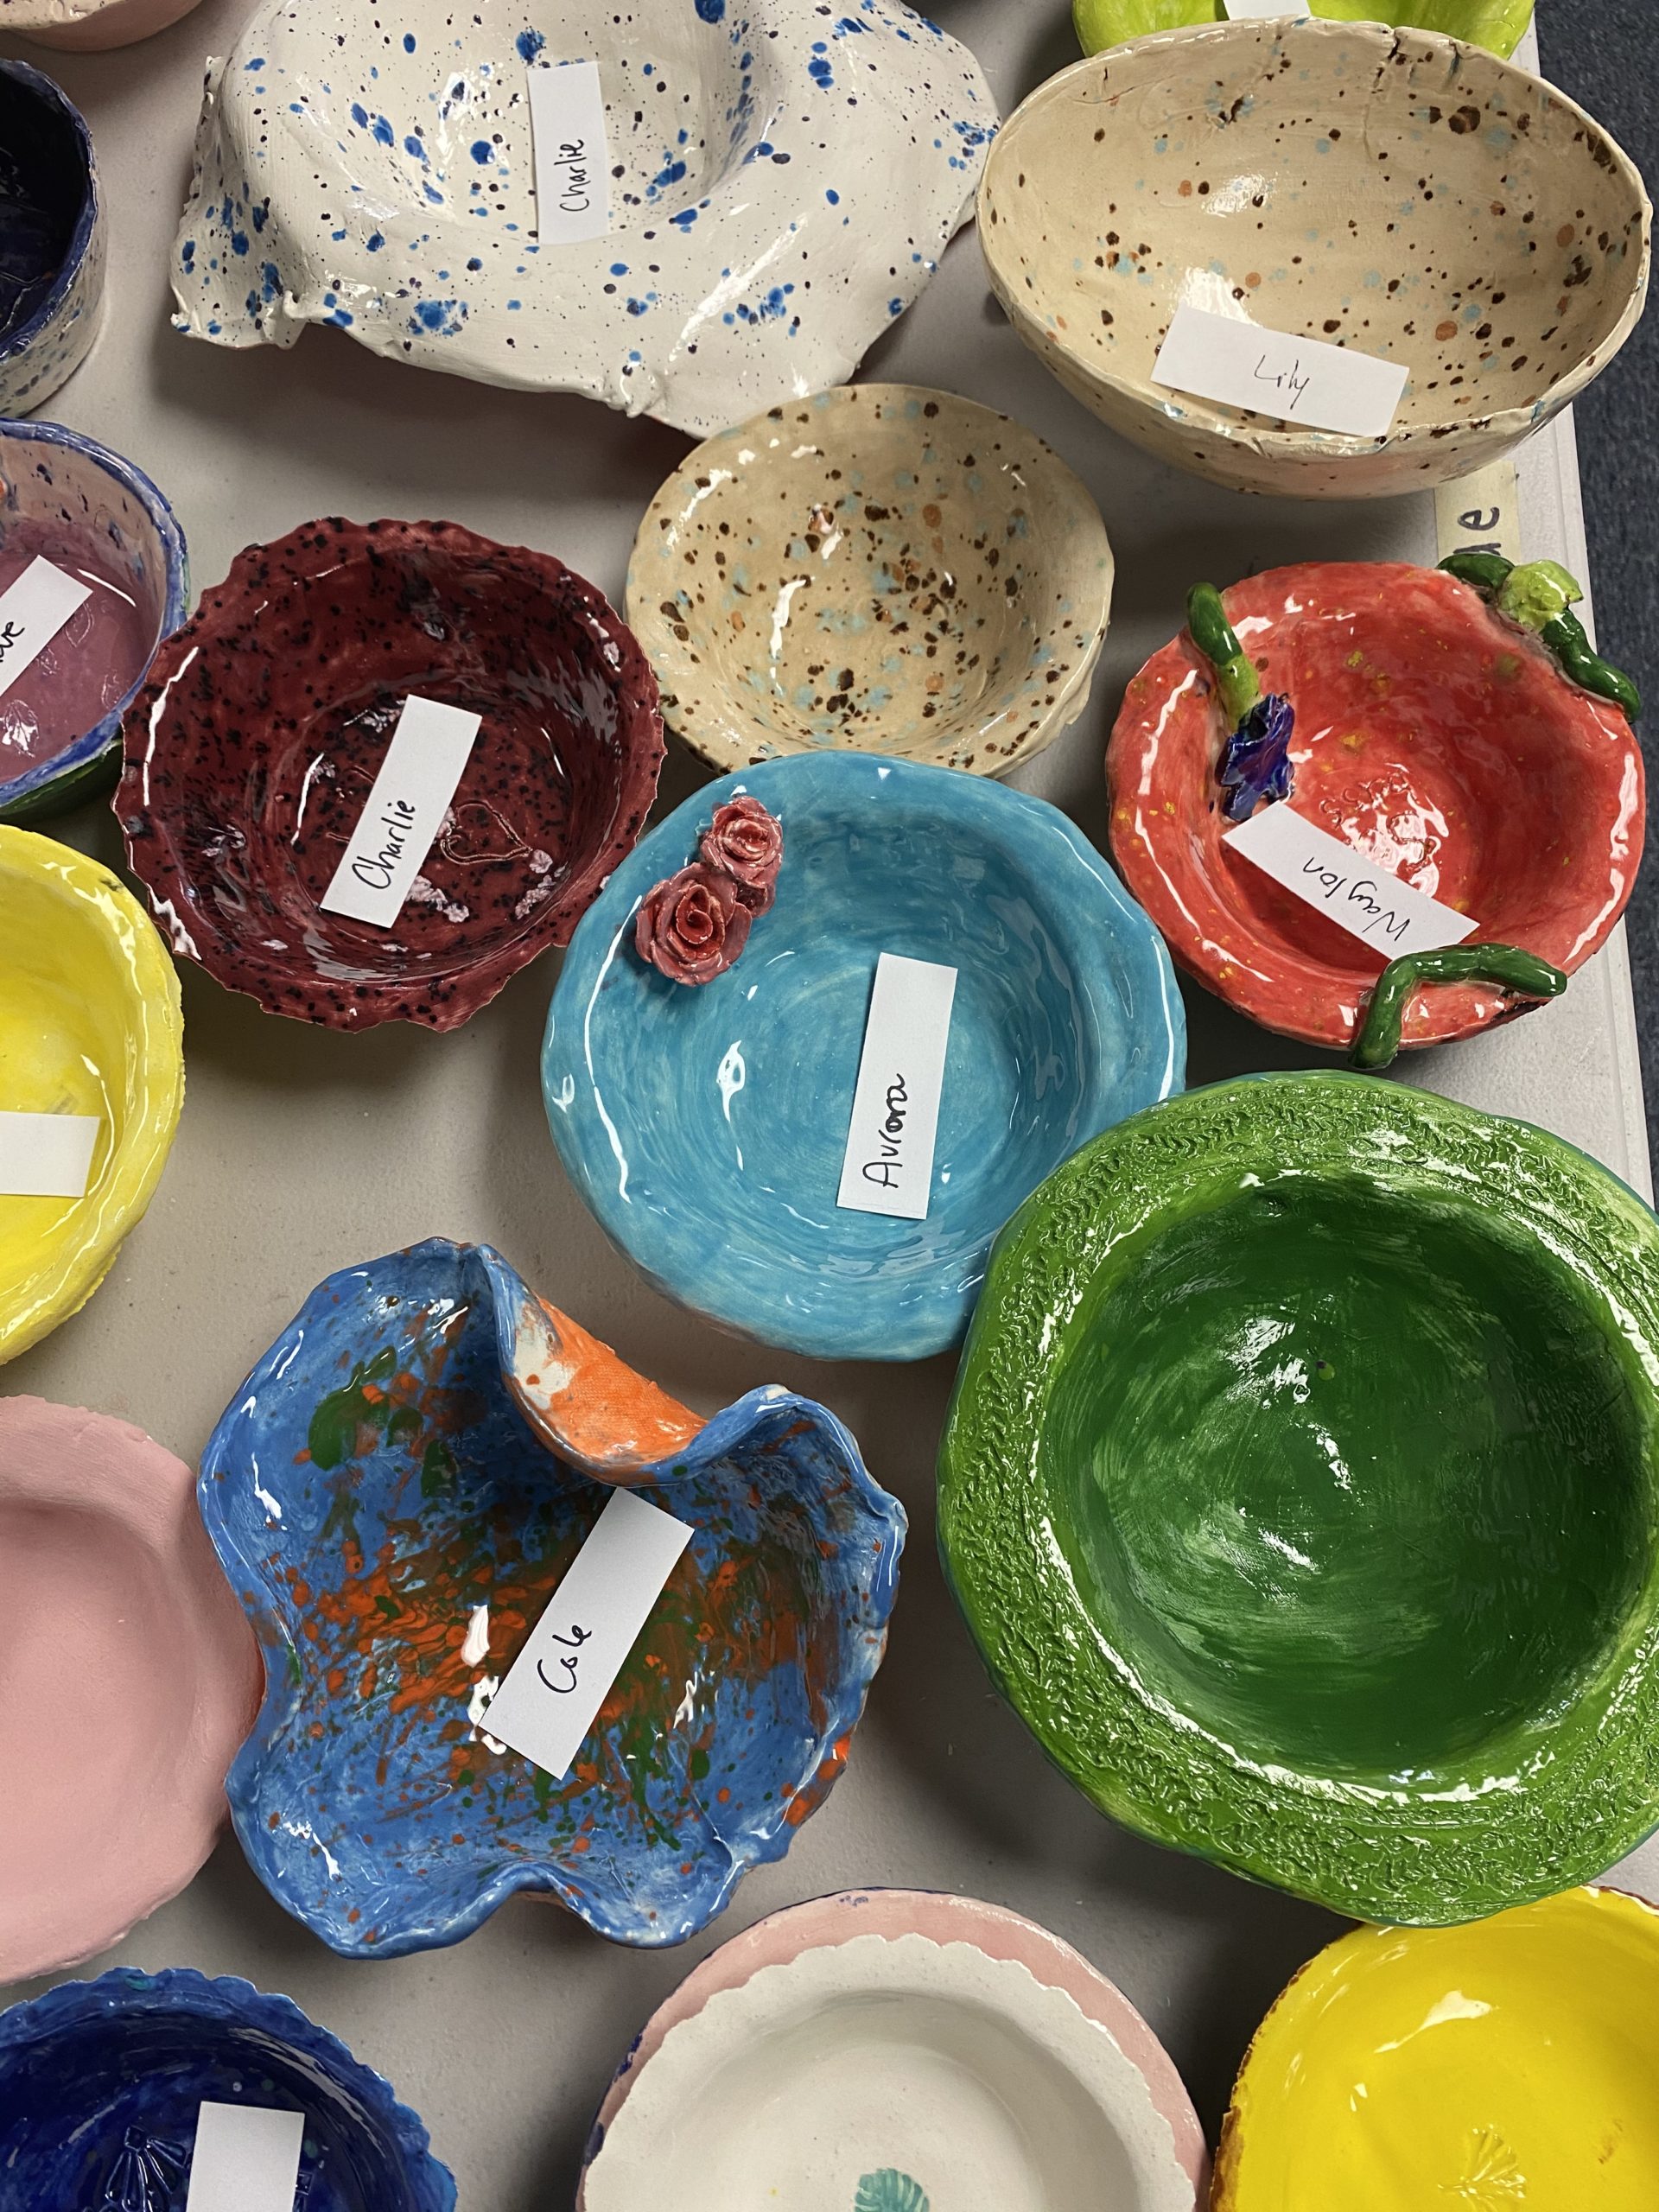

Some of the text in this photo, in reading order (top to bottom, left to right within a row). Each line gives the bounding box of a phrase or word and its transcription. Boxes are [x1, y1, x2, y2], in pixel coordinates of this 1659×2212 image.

[553, 139, 591, 212] Charlie
[1254, 354, 1310, 410] Lily
[352, 800, 416, 890] Charlie
[1302, 856, 1411, 942] Waylon
[862, 1073, 908, 1189] Aurora
[537, 1624, 593, 1694] Cole
